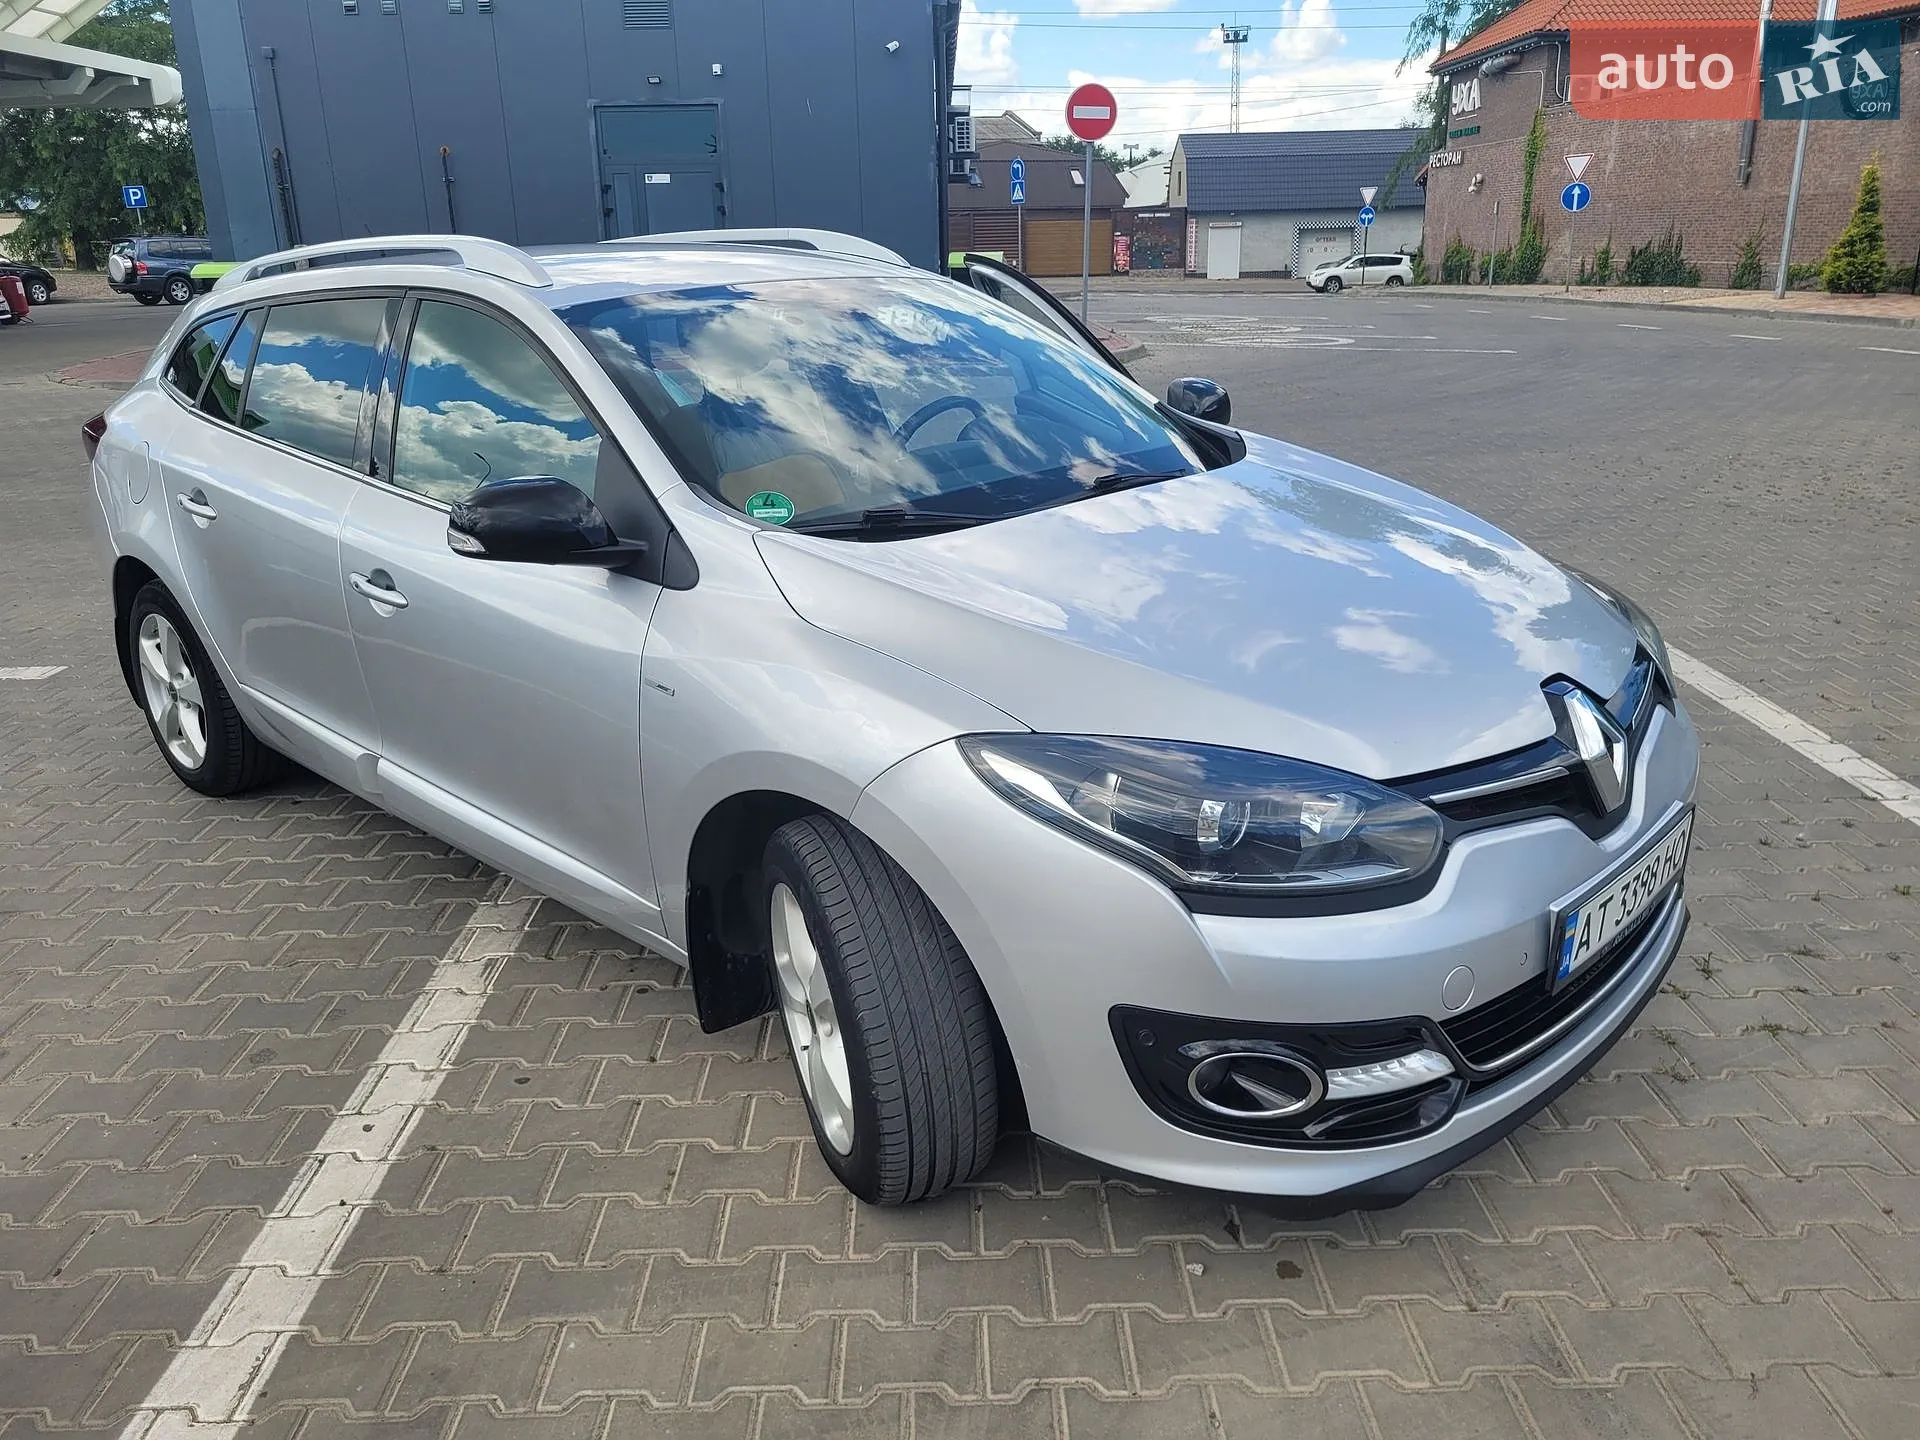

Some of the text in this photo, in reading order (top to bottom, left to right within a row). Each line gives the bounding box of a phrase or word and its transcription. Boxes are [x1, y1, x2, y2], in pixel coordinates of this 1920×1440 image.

[1452, 78, 1481, 116] УХА
[1429, 150, 1462, 168] РЕСТОРАН
[129, 188, 141, 205] P
[762, 493, 776, 508] 4
[1574, 894, 1614, 962] AT
[1614, 854, 1661, 926] 3398
